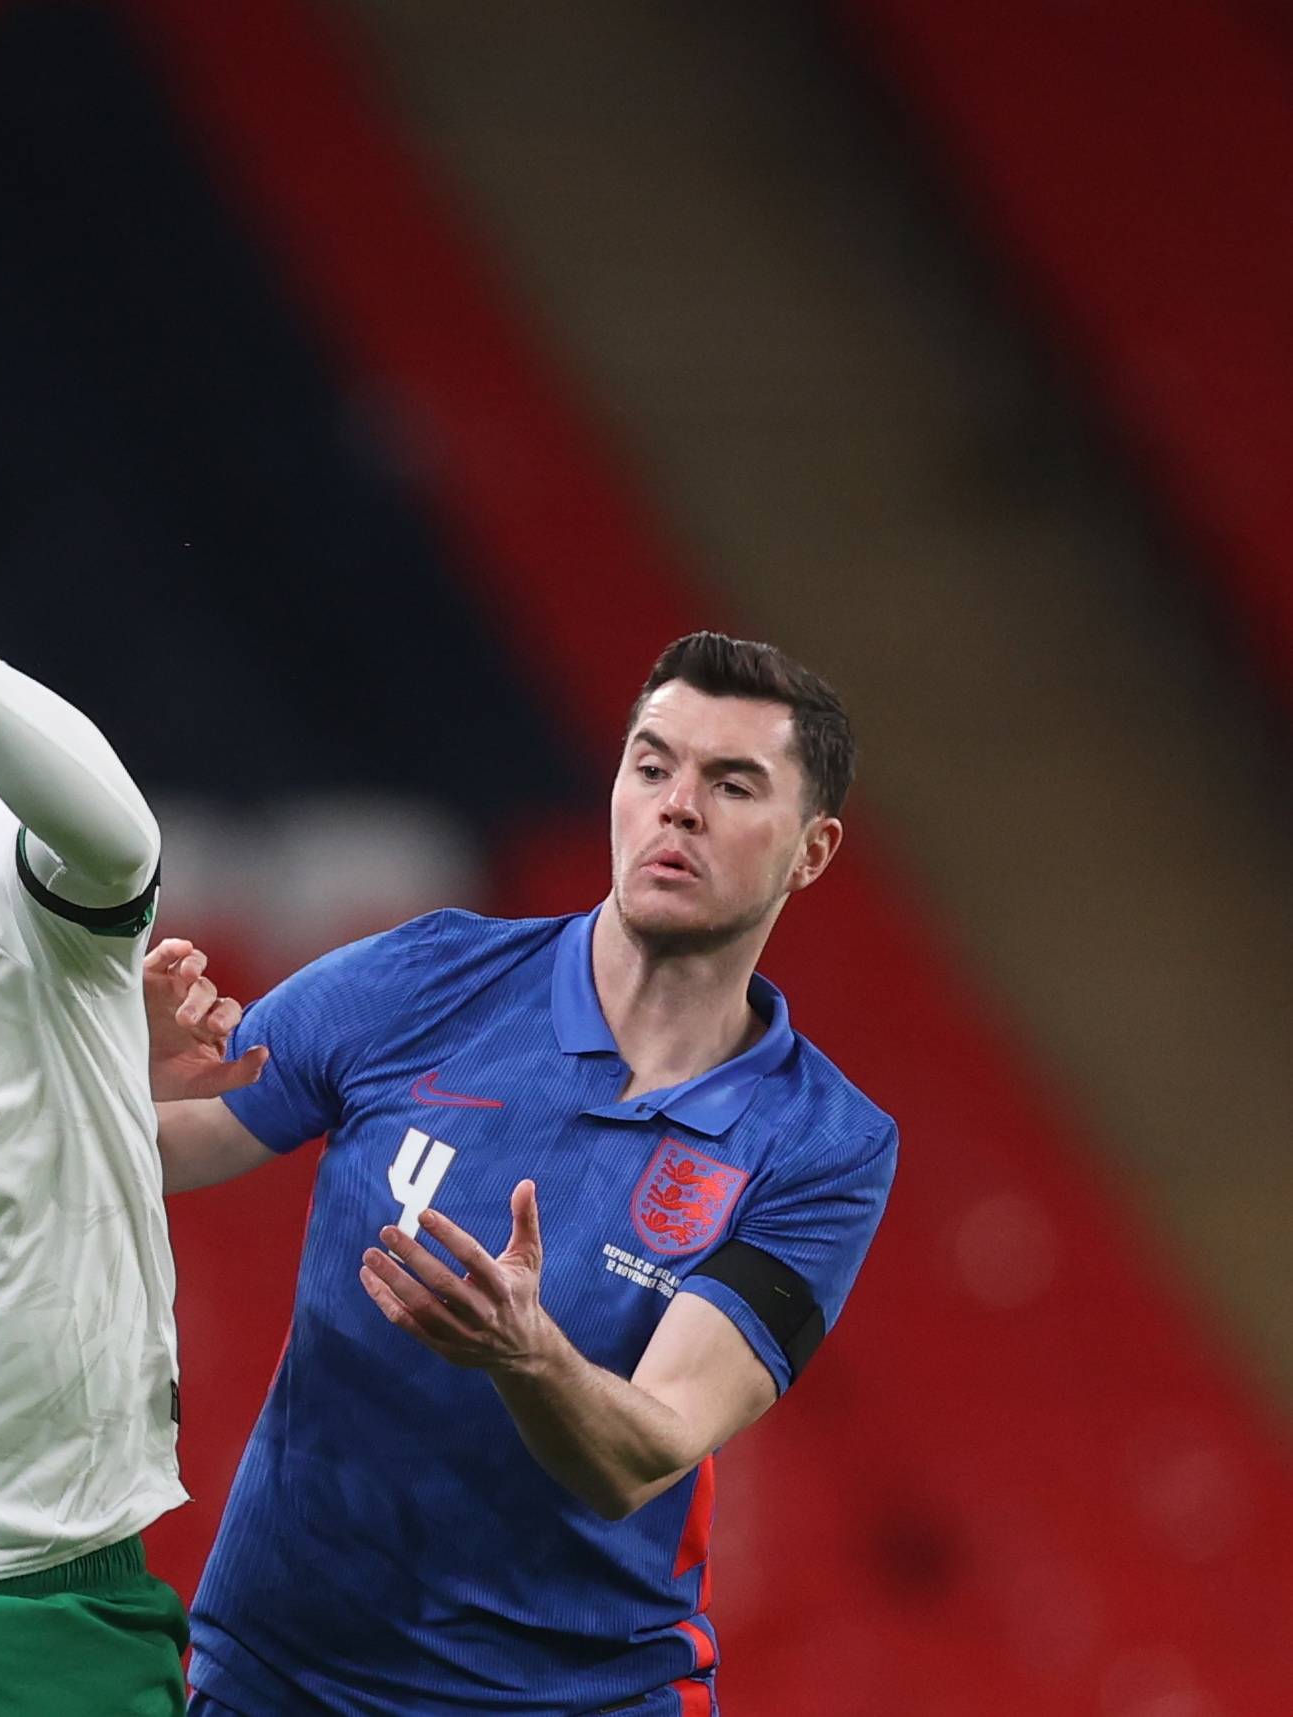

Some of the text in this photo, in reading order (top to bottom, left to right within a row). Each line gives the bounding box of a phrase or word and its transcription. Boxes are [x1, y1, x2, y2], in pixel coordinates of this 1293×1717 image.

[388, 1127, 457, 1264] 4
[602, 1243, 644, 1270] REPUBLIC
[642, 1262, 656, 1275] OF
[606, 1259, 616, 1272] 12
